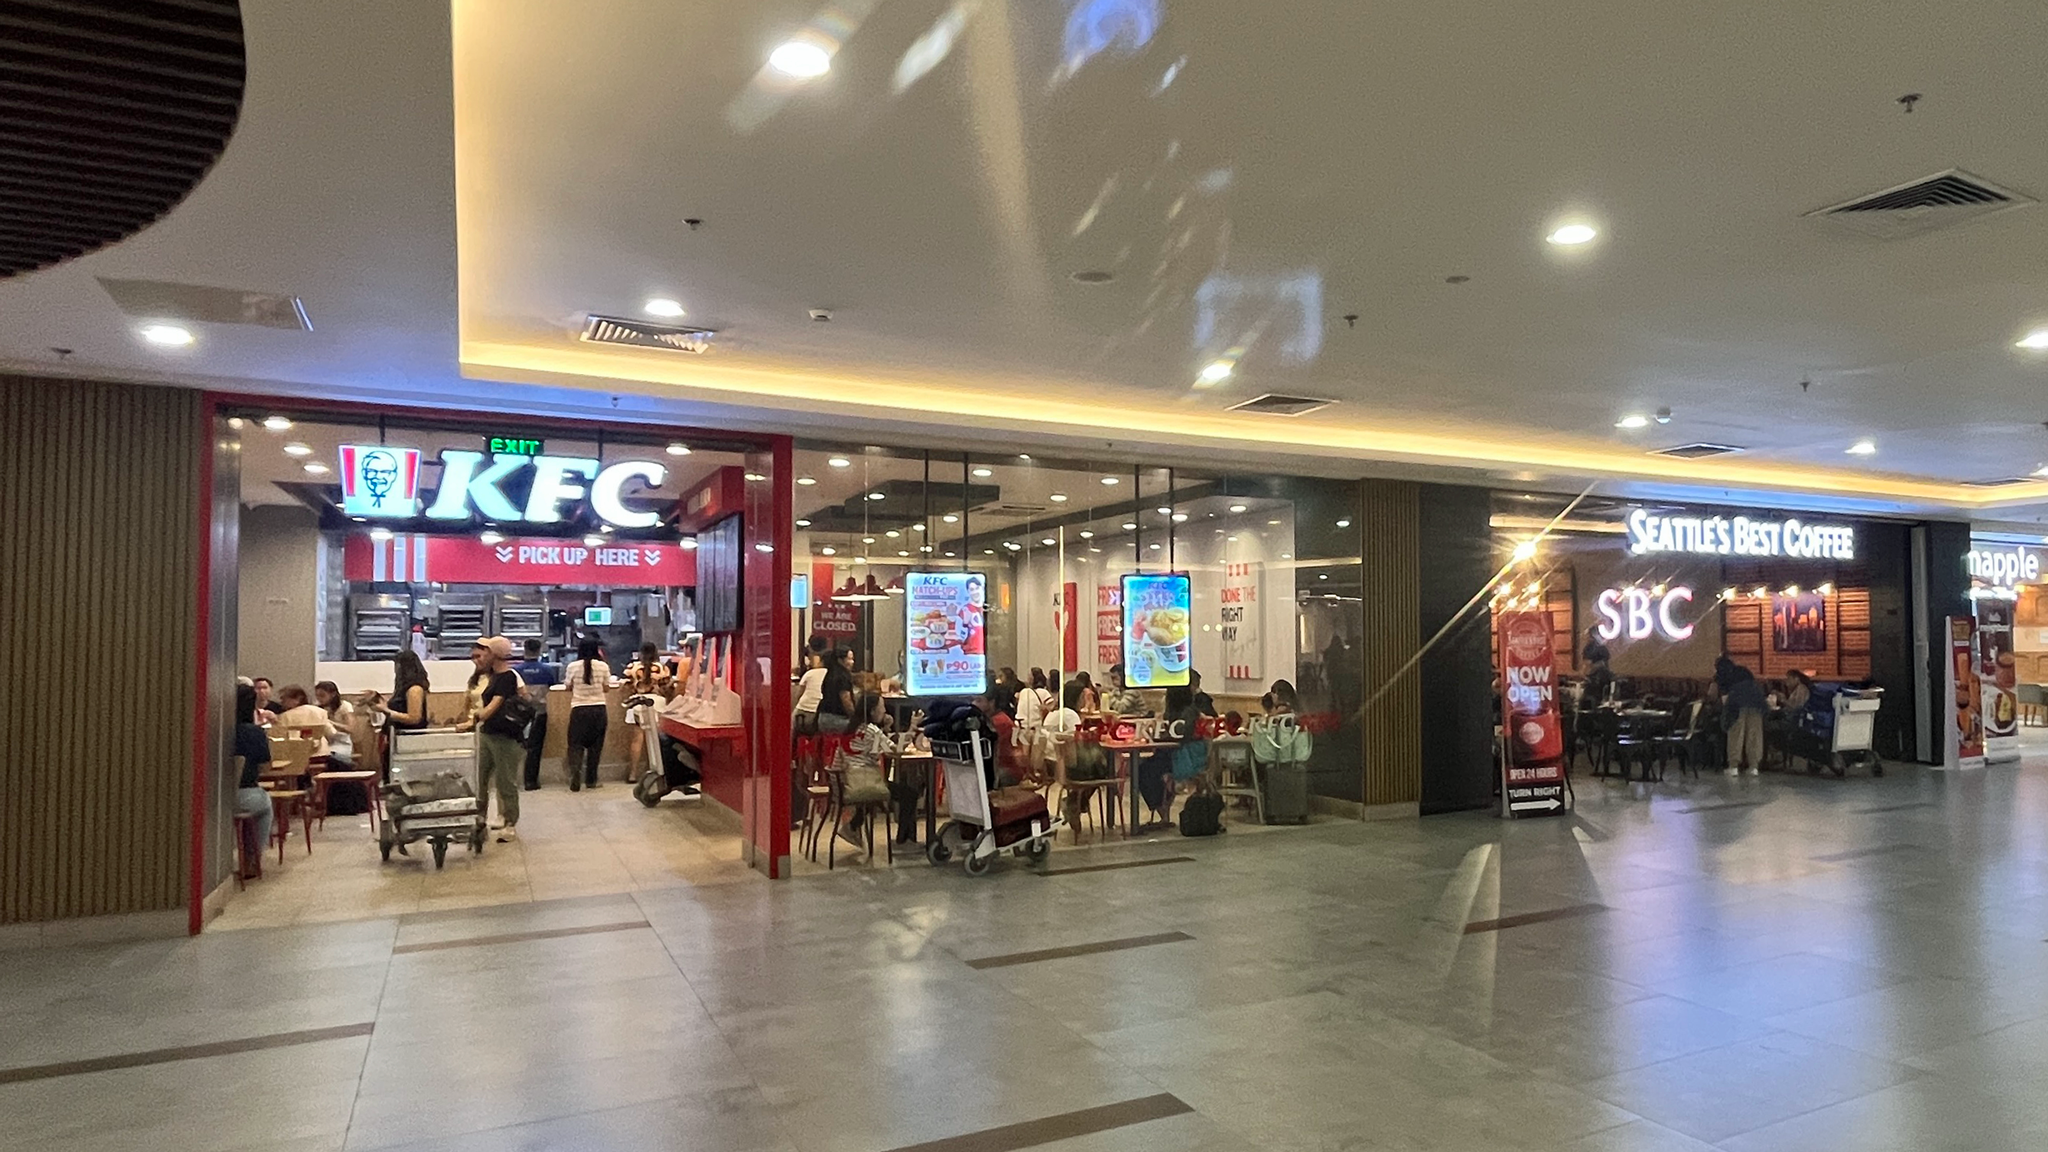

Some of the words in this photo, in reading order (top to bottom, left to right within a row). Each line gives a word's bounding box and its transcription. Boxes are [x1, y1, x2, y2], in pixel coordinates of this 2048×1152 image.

[491, 438, 540, 454] EXIT
[426, 449, 667, 528] KFC
[519, 546, 561, 565] PICK
[564, 547, 588, 565] UP
[595, 548, 639, 566] HERE
[923, 576, 948, 586] KFC
[1221, 588, 1240, 603] DONE
[1242, 585, 1256, 602] THE
[1221, 607, 1244, 622] RIGHT
[1598, 586, 1694, 640] SBC
[813, 621, 856, 631] CLOSED
[1221, 626, 1237, 641] WAY
[1506, 665, 1550, 683] NOW
[1507, 685, 1553, 702] OPEN
[1134, 719, 1186, 744] KFC
[1526, 768, 1536, 779] 24
[1536, 766, 1558, 779] HOURS
[1508, 788, 1532, 799] TURN
[1533, 786, 1561, 797] RIGHT
